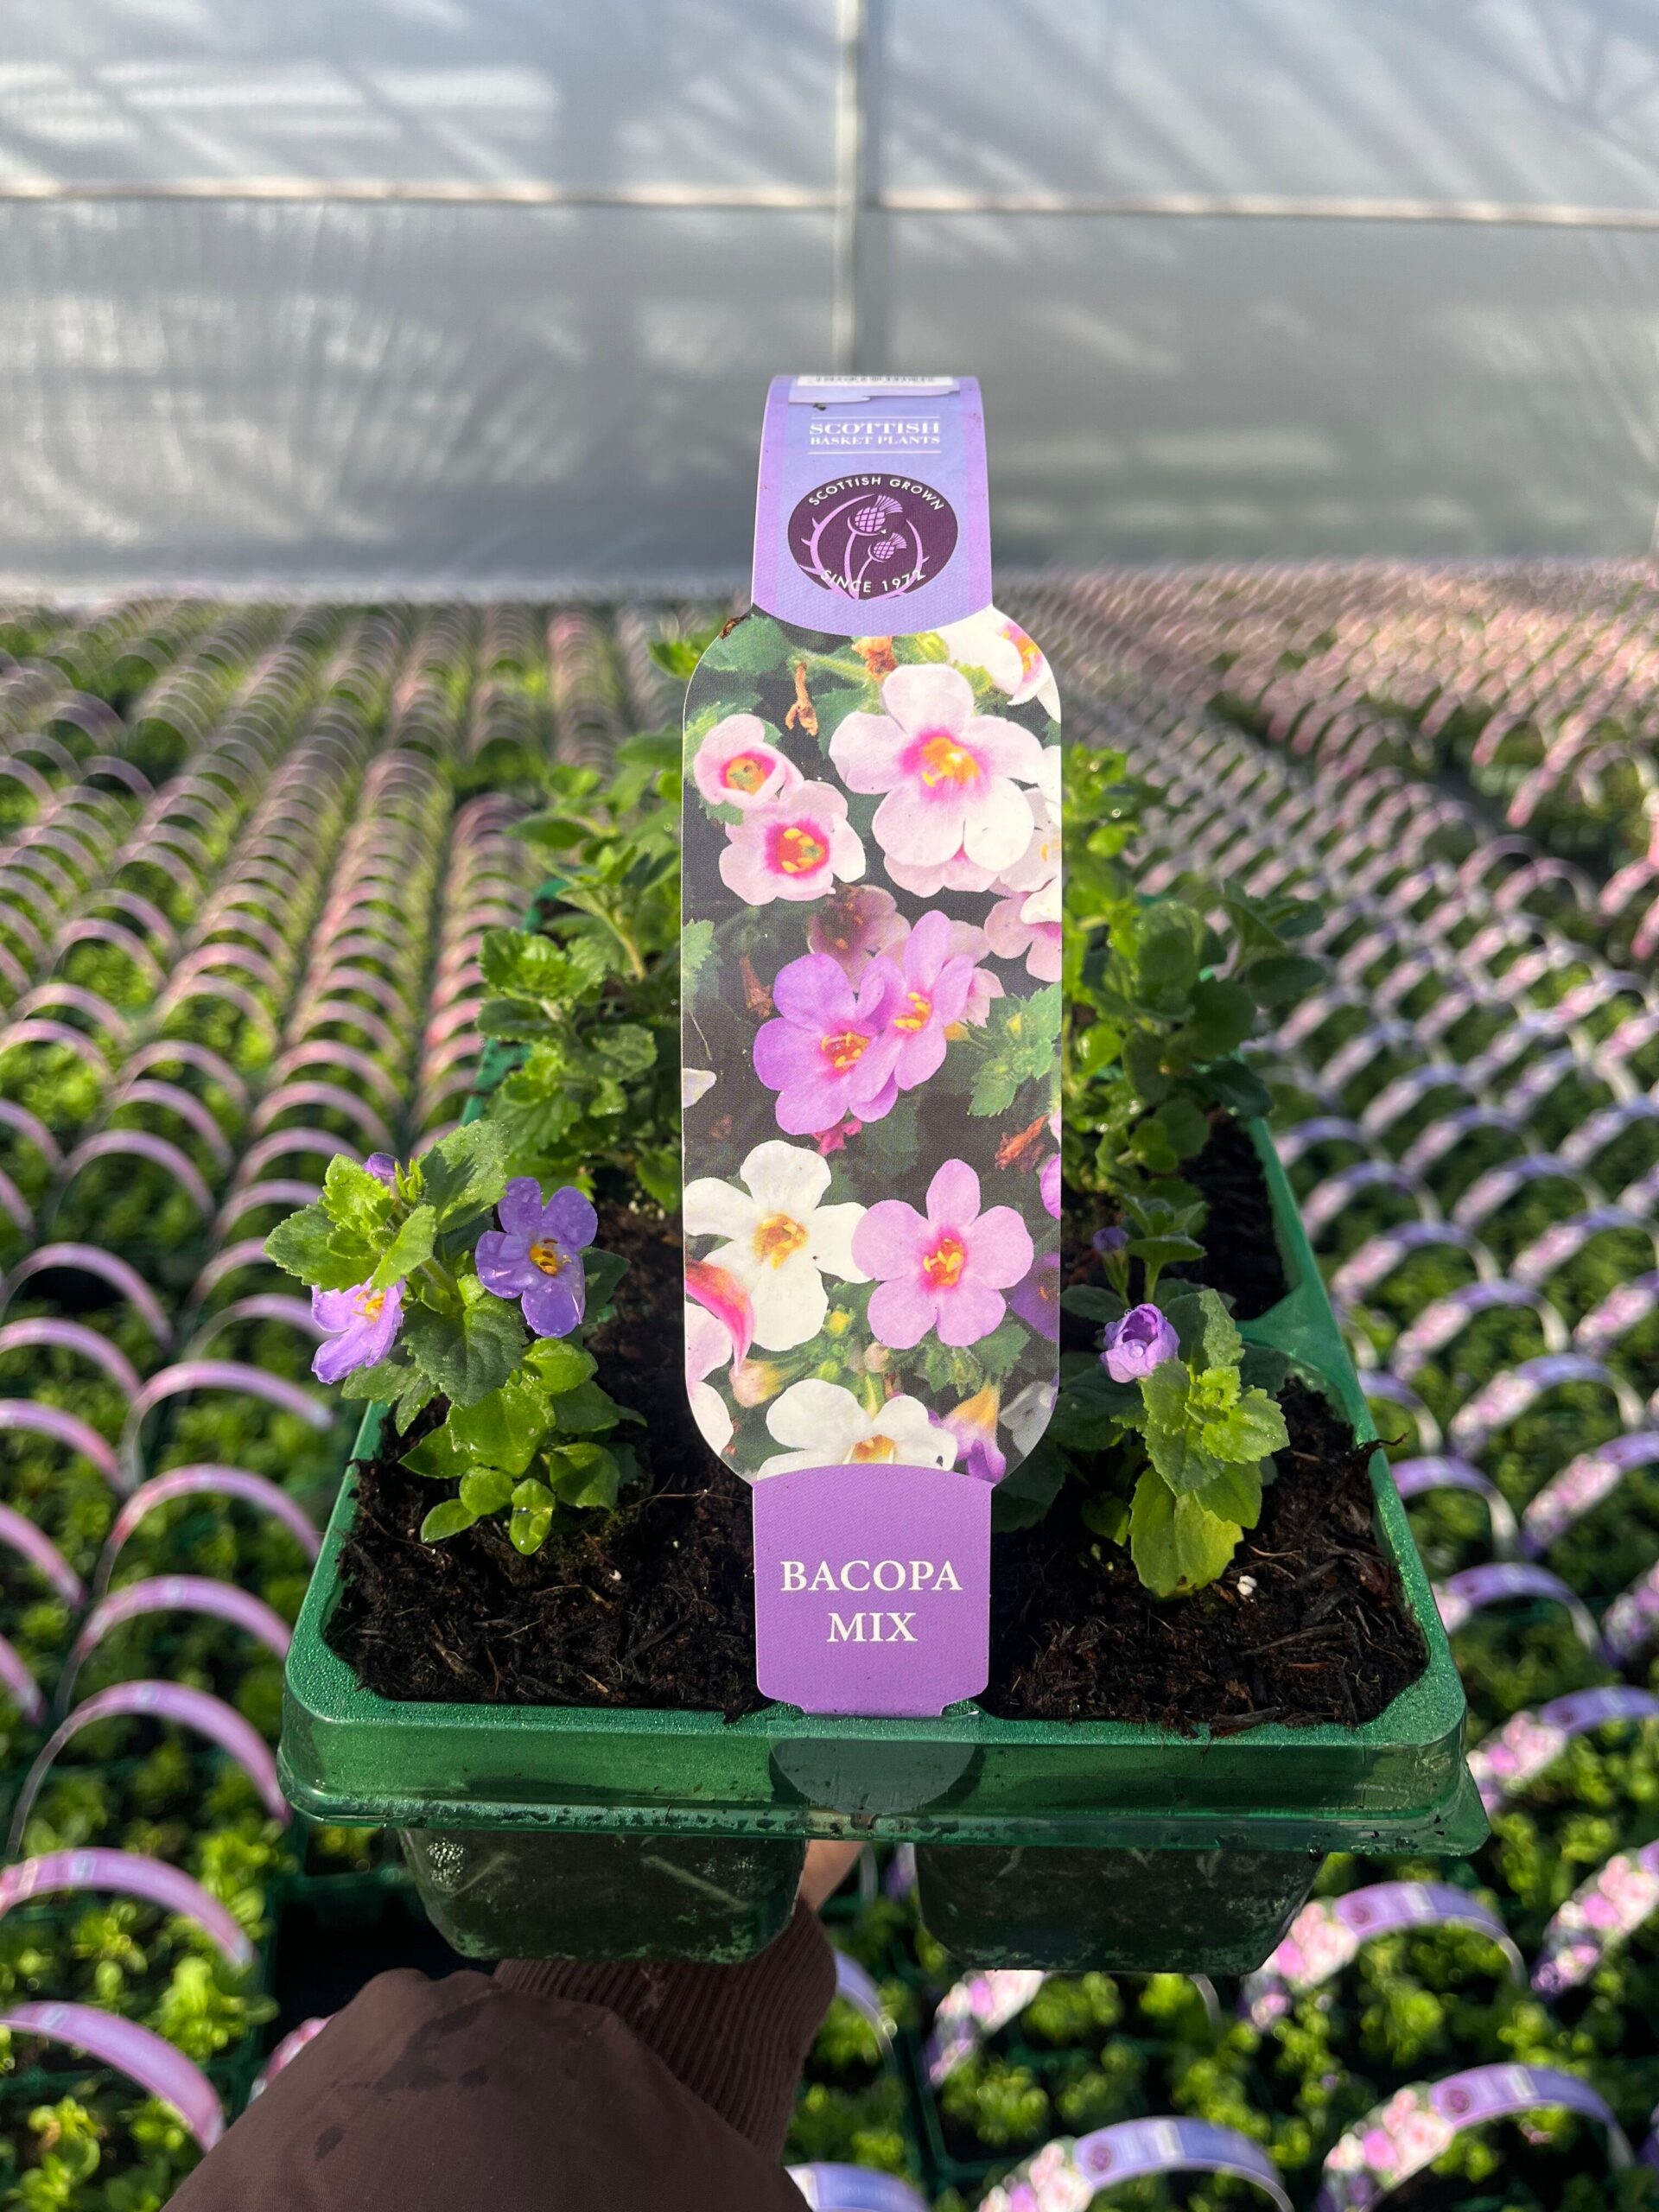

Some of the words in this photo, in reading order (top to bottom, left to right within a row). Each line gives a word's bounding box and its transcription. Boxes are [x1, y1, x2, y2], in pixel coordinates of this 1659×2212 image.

[810, 421, 940, 435] SCOTTISH
[810, 435, 874, 446] BASKET
[877, 435, 940, 445] PLANTS
[809, 476, 881, 506] SCOTTISH
[889, 479, 944, 511] GROWN
[820, 569, 872, 593] SINCE
[882, 569, 927, 592] 1972
[780, 1560, 963, 1592] BACOPA
[826, 1611, 918, 1643] MIX
